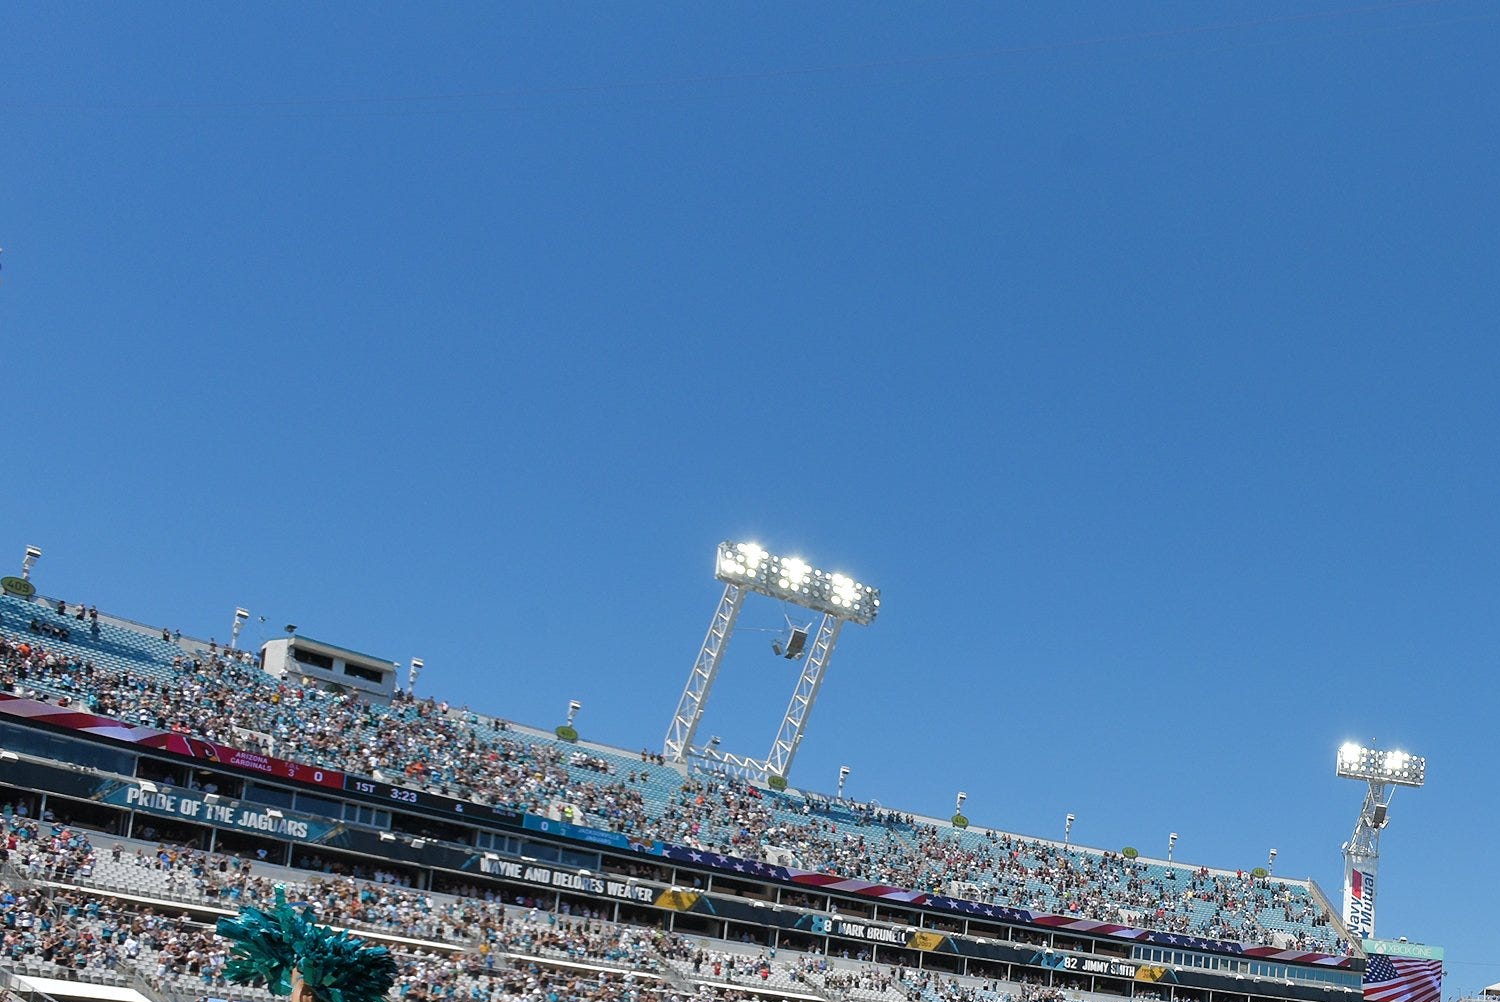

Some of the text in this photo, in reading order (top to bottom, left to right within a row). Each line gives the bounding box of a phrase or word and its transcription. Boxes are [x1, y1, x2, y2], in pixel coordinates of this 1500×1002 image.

[6, 580, 29, 592] 409
[230, 757, 272, 772] CARDINALS
[235, 752, 268, 764] ARIZONA
[288, 768, 295, 778] 3
[313, 772, 323, 782] 0
[355, 781, 417, 803] 1ST 3:23
[127, 787, 308, 838] PRIDE OF THE JAGUARS
[541, 822, 548, 831] 0
[480, 857, 522, 879] WAYNE
[524, 866, 550, 884] AND
[552, 871, 604, 894] DELORES
[607, 881, 653, 902] WEAVER
[1360, 871, 1375, 927] Mutual
[1346, 896, 1363, 936] Navy
[838, 920, 864, 937] MARK
[1064, 957, 1077, 970] 82
[1082, 960, 1109, 974] JIMMY
[1111, 964, 1136, 977] SMITH
